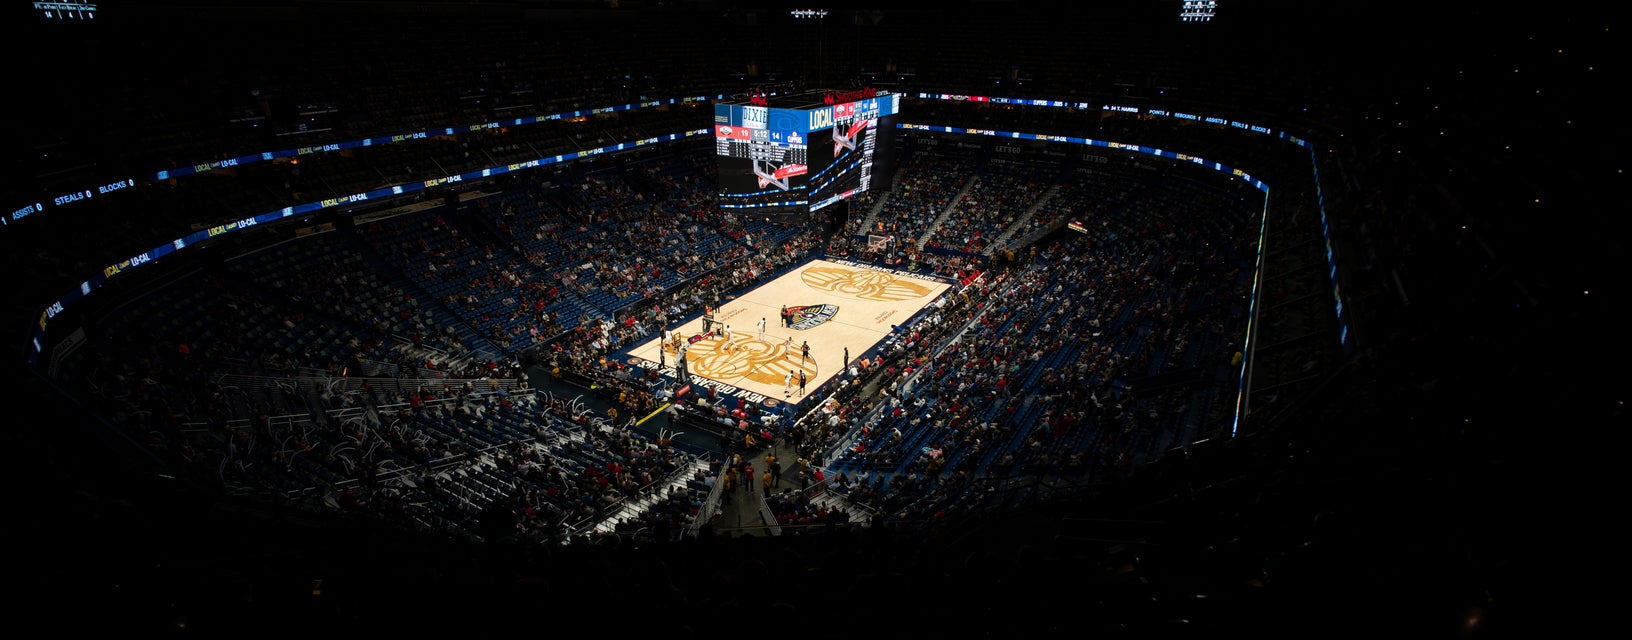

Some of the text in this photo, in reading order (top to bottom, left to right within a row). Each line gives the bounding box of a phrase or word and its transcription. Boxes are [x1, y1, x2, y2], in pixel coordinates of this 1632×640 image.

[744, 108, 768, 124] DIXIE
[810, 108, 833, 130] LOCAL
[772, 132, 780, 140] 14
[298, 146, 314, 155] LOCAL
[323, 144, 340, 152] LO-CAL
[195, 163, 212, 173] LOCAL
[221, 158, 239, 168] LO-CAL
[425, 179, 440, 188] LOCAL
[447, 175, 463, 184] LO-CAL
[13, 205, 35, 221] ASSISTS
[36, 203, 43, 212] 0
[55, 192, 84, 206] STEALS
[86, 190, 93, 198] 0
[99, 180, 127, 194] BLOCKS
[128, 179, 135, 187] 0
[321, 198, 339, 208] LOCAL
[349, 193, 368, 203] LO-CAL
[208, 225, 227, 237] LOCAL
[238, 217, 258, 229] LO-CAL
[130, 253, 151, 267] LO-CAL
[895, 270, 936, 281] PELICANS
[46, 301, 64, 319] LO-CAL
[732, 391, 767, 404] NEW
